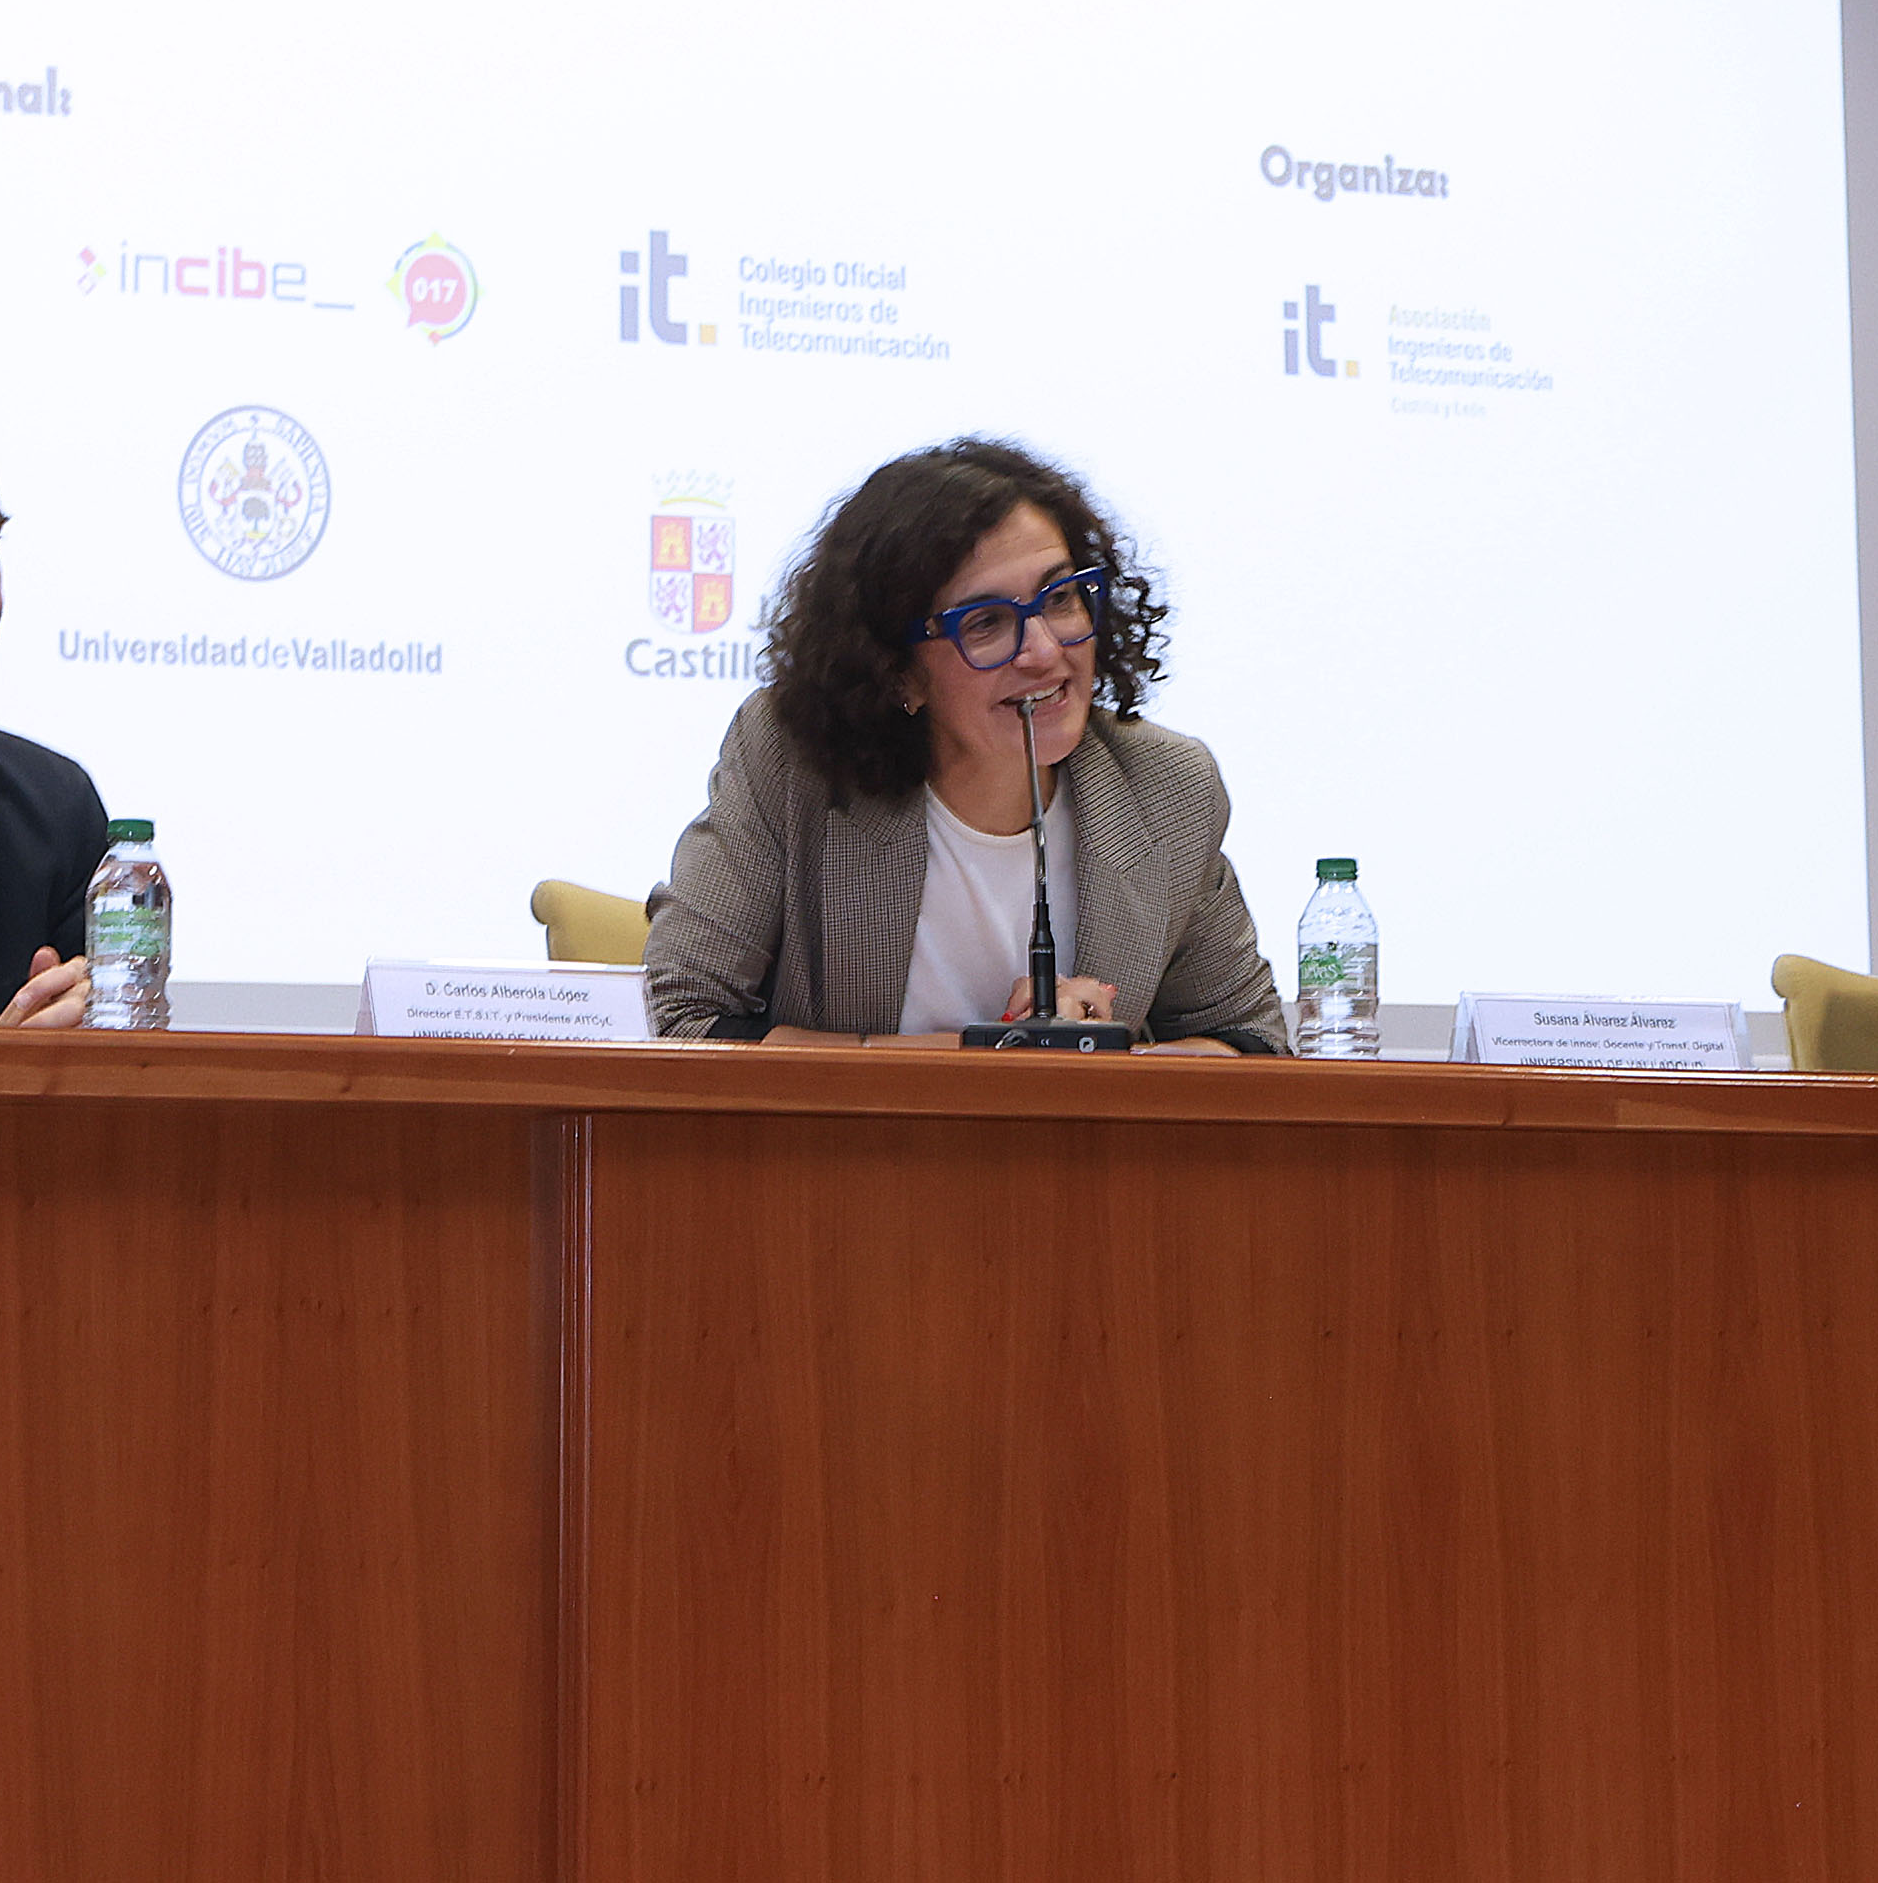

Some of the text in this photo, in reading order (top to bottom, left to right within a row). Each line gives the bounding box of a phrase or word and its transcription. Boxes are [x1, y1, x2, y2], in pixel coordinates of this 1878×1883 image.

[1260, 145, 1449, 202] Organiza:
[739, 254, 907, 292] Colegio Oficial
[411, 277, 459, 306] 017
[739, 290, 898, 329] Ingenieros de
[739, 323, 950, 362] Telecomunicación
[1388, 334, 1513, 363] Ingenieros de
[1388, 361, 1553, 392] Telecomunicación
[625, 638, 764, 680] Castill
[425, 982, 590, 1005] D. Carlos Alberola López
[407, 1007, 451, 1020] Director
[504, 1013, 512, 1024] y
[514, 1011, 571, 1025] Presidente
[1534, 1010, 1676, 1030] Susana Álvarez Álvarez
[1492, 1036, 1554, 1048] Vicerrectora
[1556, 1038, 1568, 1048] de
[1647, 1041, 1654, 1052] y
[1692, 1041, 1724, 1054] Digital
